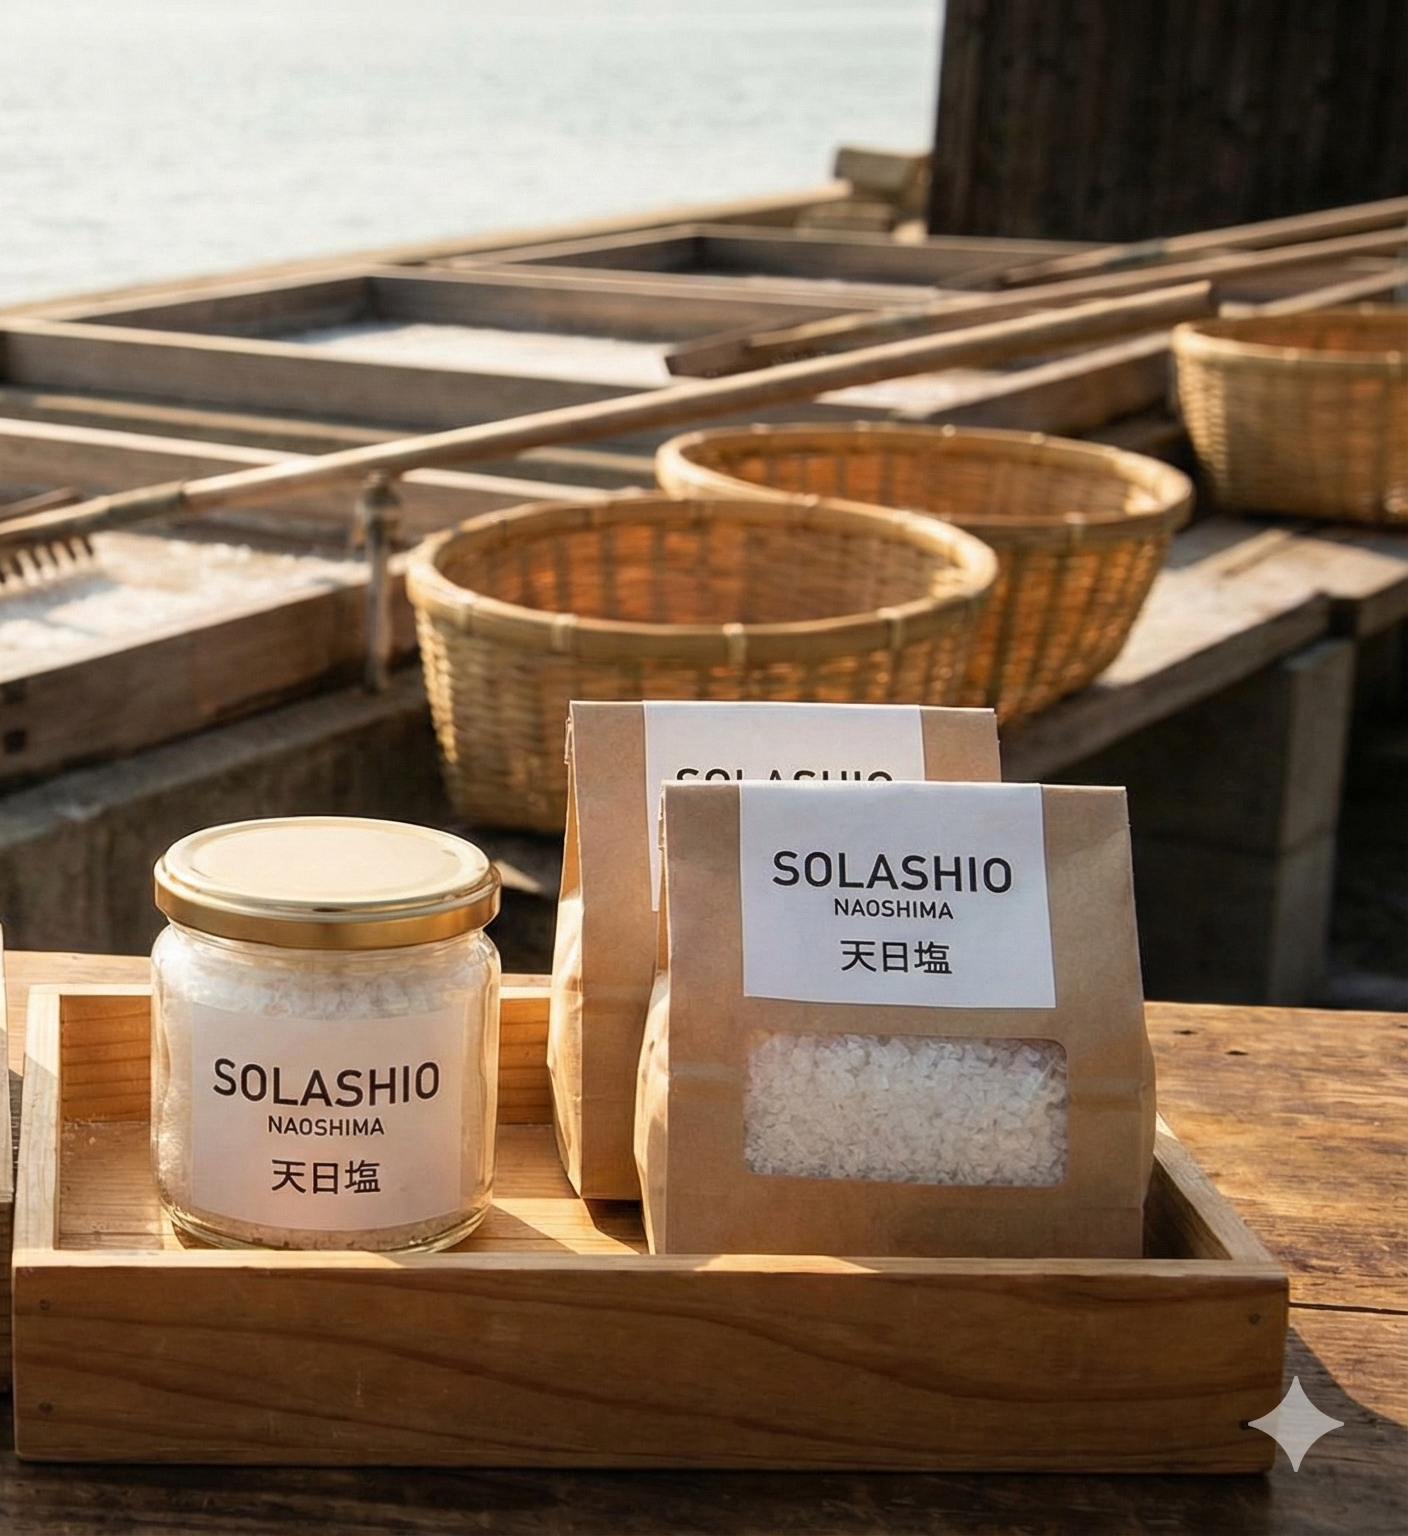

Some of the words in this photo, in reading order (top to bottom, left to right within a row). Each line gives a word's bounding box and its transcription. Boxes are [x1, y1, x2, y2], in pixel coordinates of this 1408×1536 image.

[772, 850, 1012, 894] SOLASHIO
[834, 898, 954, 920] NAOSHIMA
[840, 940, 953, 975] 天日塩
[213, 1058, 440, 1108] SOLASHIO
[268, 1115, 385, 1137] NAOSHIMA
[271, 1159, 381, 1195] 天日塩
